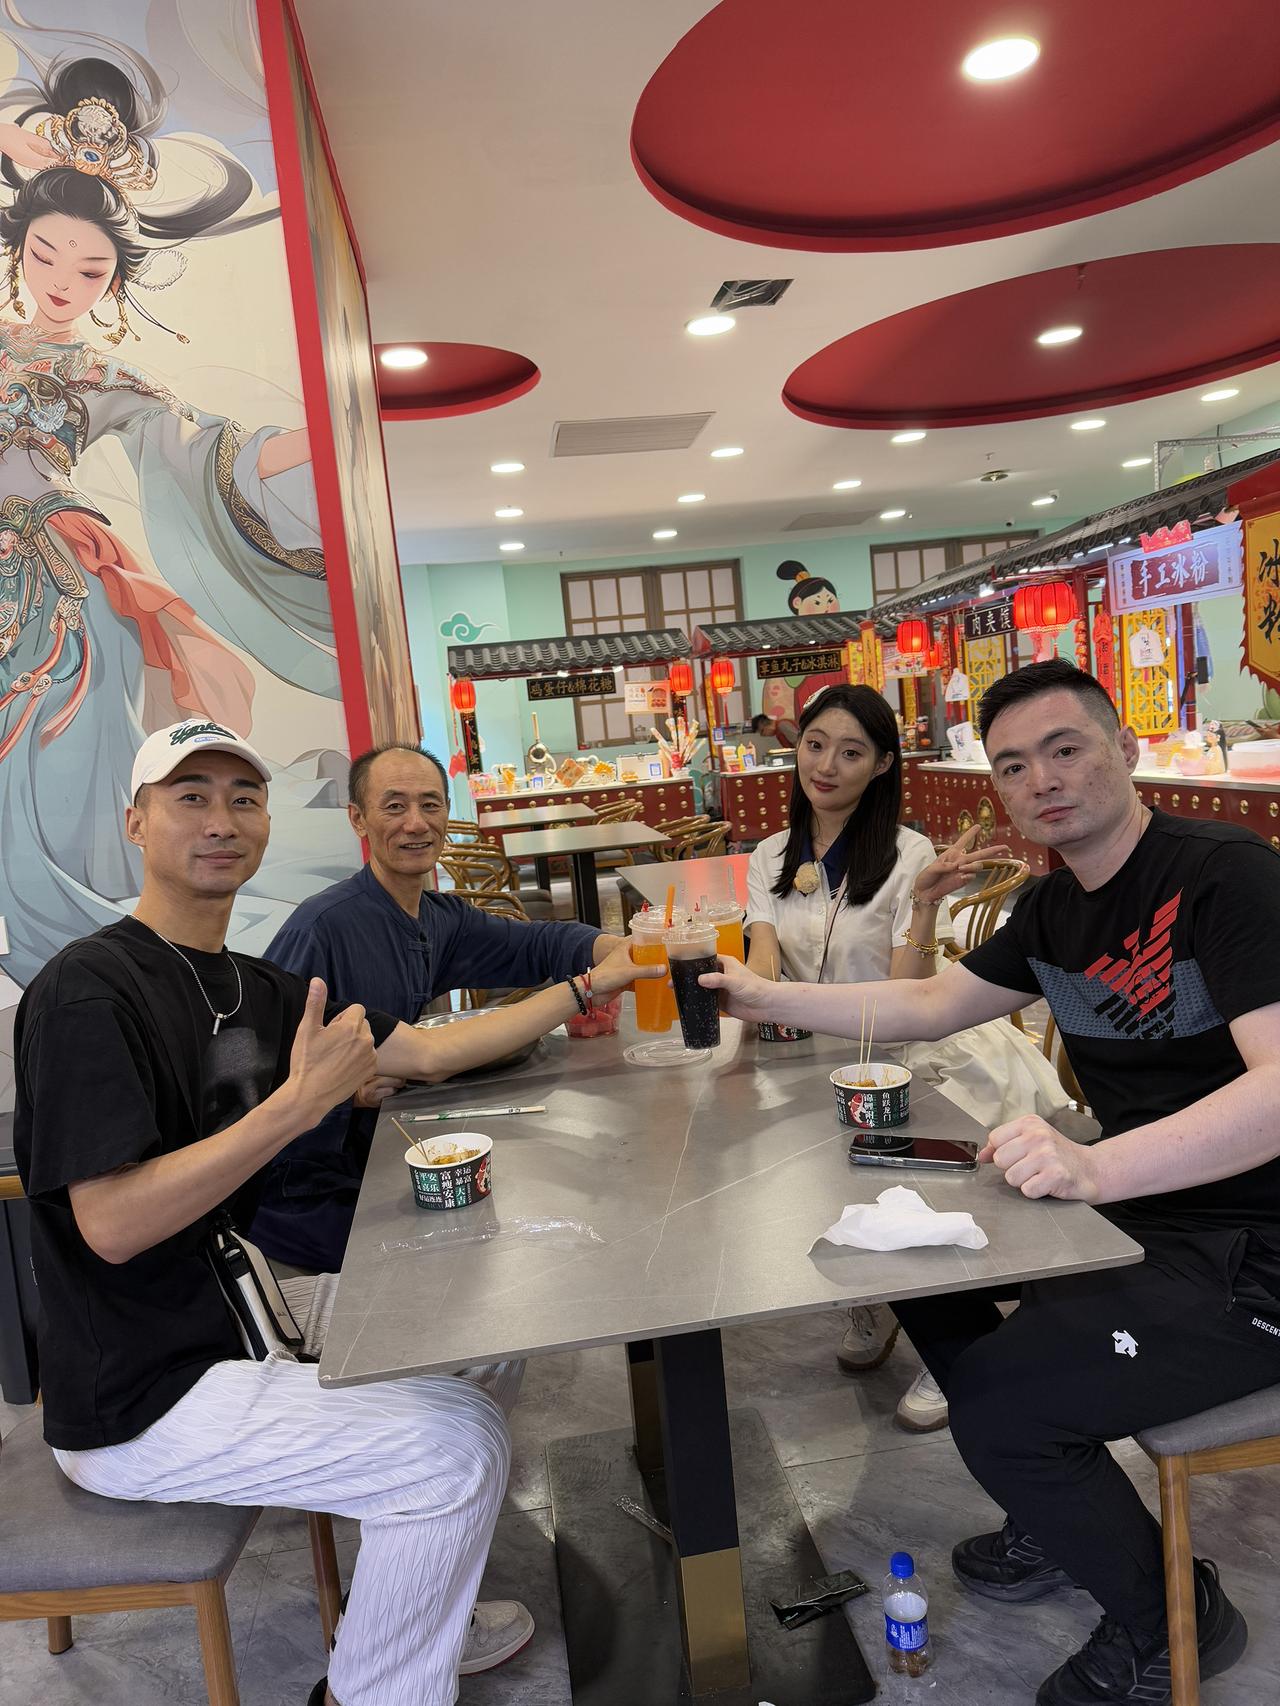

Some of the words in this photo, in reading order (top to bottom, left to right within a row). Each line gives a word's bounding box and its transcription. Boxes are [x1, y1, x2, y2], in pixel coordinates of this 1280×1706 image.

[1138, 550, 1209, 596] 手工冰粉
[972, 606, 1011, 635] 肉夹馍
[759, 654, 839, 674] 章鱼丸子&冰淇淋
[530, 676, 613, 697] 鸡蛋仔&棉花糖
[882, 1092, 892, 1122] 鱼跃龙门
[420, 1172, 437, 1182] 平安
[456, 1187, 466, 1206] 大吉
